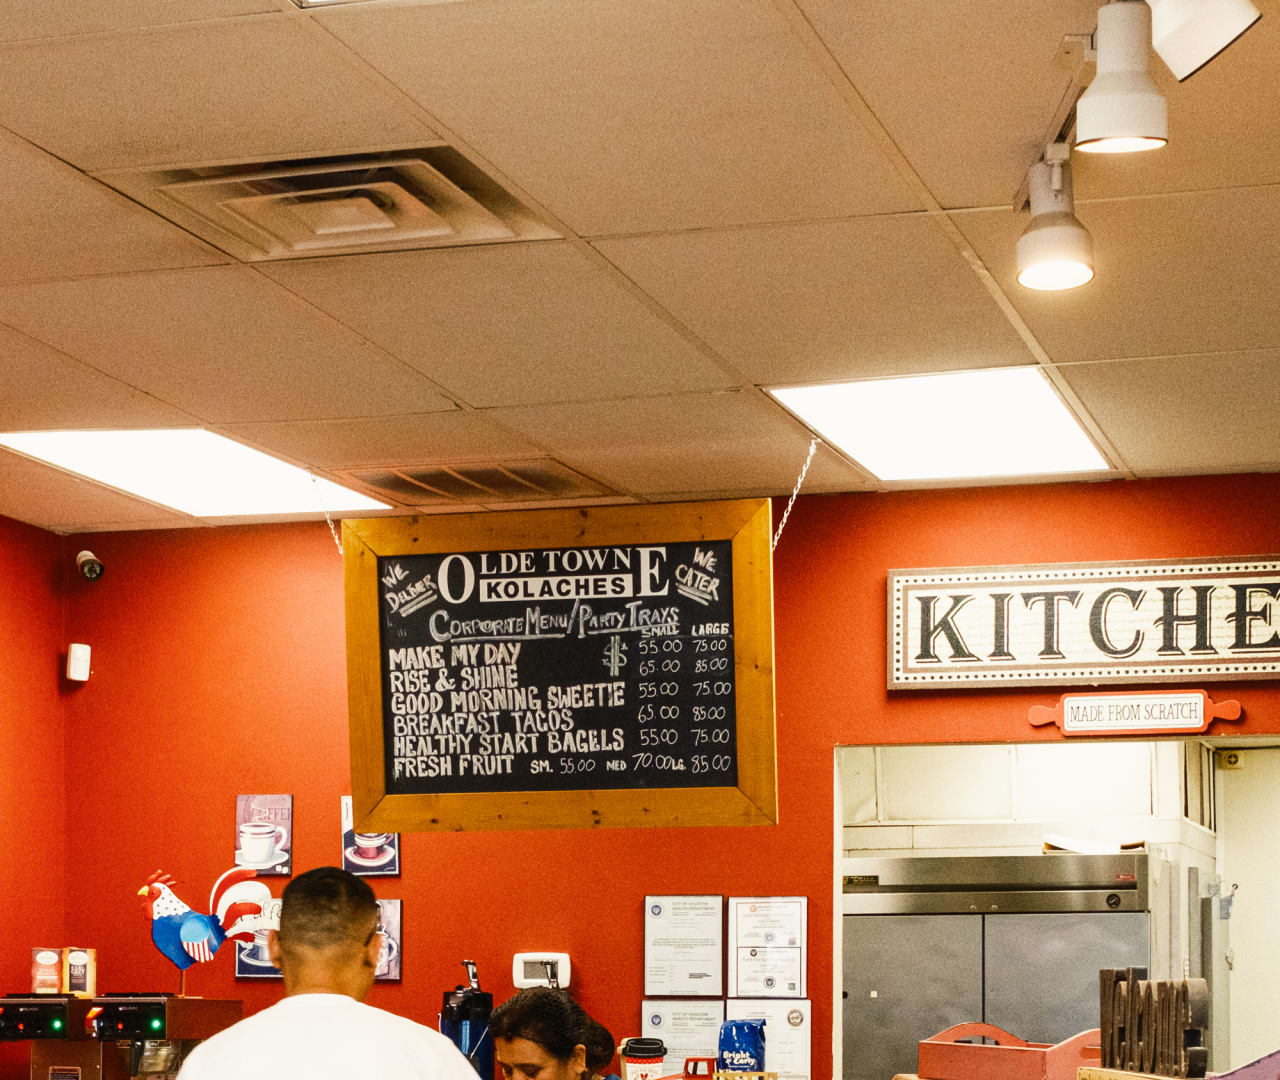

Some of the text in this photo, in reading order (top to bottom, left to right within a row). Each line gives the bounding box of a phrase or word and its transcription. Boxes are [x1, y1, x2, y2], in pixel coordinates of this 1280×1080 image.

[693, 547, 718, 573] WE
[381, 563, 410, 588] WE
[487, 577, 626, 600] KOLACHES
[675, 564, 720, 601] CATER
[385, 574, 438, 613] DELIVER
[641, 623, 729, 638] SMALL LARGE
[389, 645, 446, 671] MAKE
[451, 644, 480, 667] MY
[484, 642, 521, 665] DAY
[639, 640, 683, 654] 55.00
[693, 640, 727, 653] 75.00
[390, 658, 728, 693] RISE & SHINE 65.00 85.00
[391, 681, 732, 715] GOOD MORNING SWEETIE 55.00 75.00
[394, 704, 726, 737] BREAKFAST TACOS 65.00 85.00
[1070, 702, 1198, 722] MADE FROM SCRATCH
[394, 728, 730, 757] HEALTHY START BAGELS 55.00 75.00
[394, 755, 452, 778] FRESH
[459, 755, 514, 776] FRUIT
[530, 760, 553, 774] SM.
[560, 758, 596, 774] 55.00
[606, 760, 627, 771] MED
[632, 753, 672, 771] 70.00
[691, 755, 731, 773] 85.00
[723, 1050, 751, 1059] Bright
